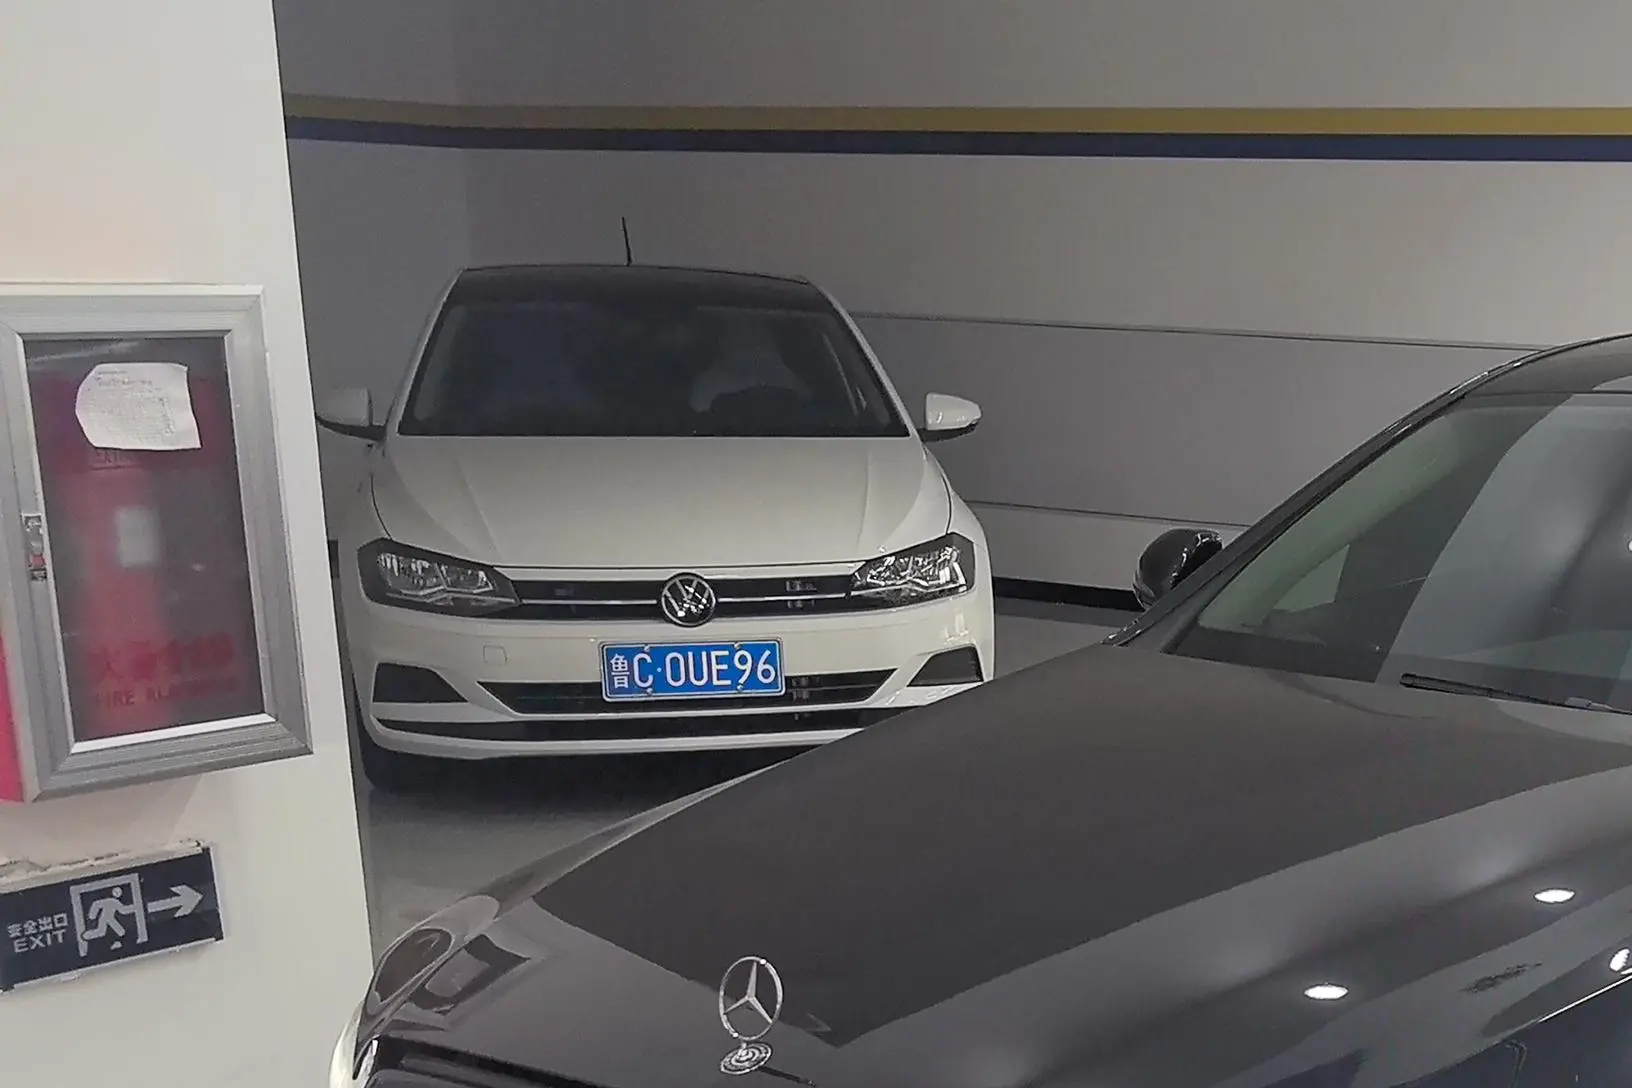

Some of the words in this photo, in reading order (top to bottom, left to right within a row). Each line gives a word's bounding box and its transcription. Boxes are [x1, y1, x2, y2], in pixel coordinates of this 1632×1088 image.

[7, 913, 68, 938] 安全出口
[14, 929, 66, 953] EXIT
